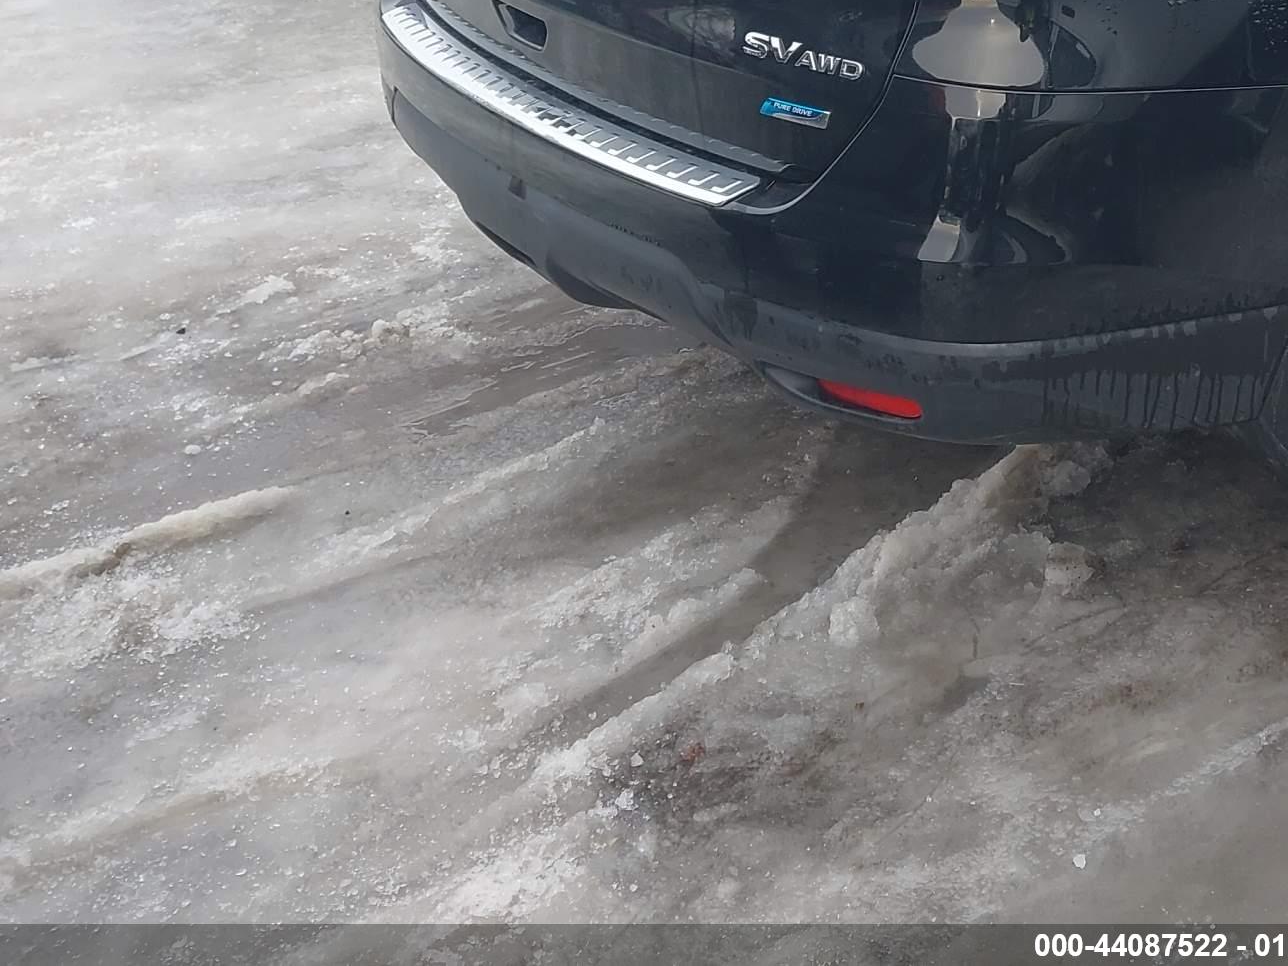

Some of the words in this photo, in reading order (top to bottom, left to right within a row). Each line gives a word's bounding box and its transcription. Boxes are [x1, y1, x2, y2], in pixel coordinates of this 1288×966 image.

[743, 32, 803, 63] SV
[795, 50, 866, 80] AWD
[773, 101, 791, 112] PURE
[792, 106, 813, 117] DRIVE
